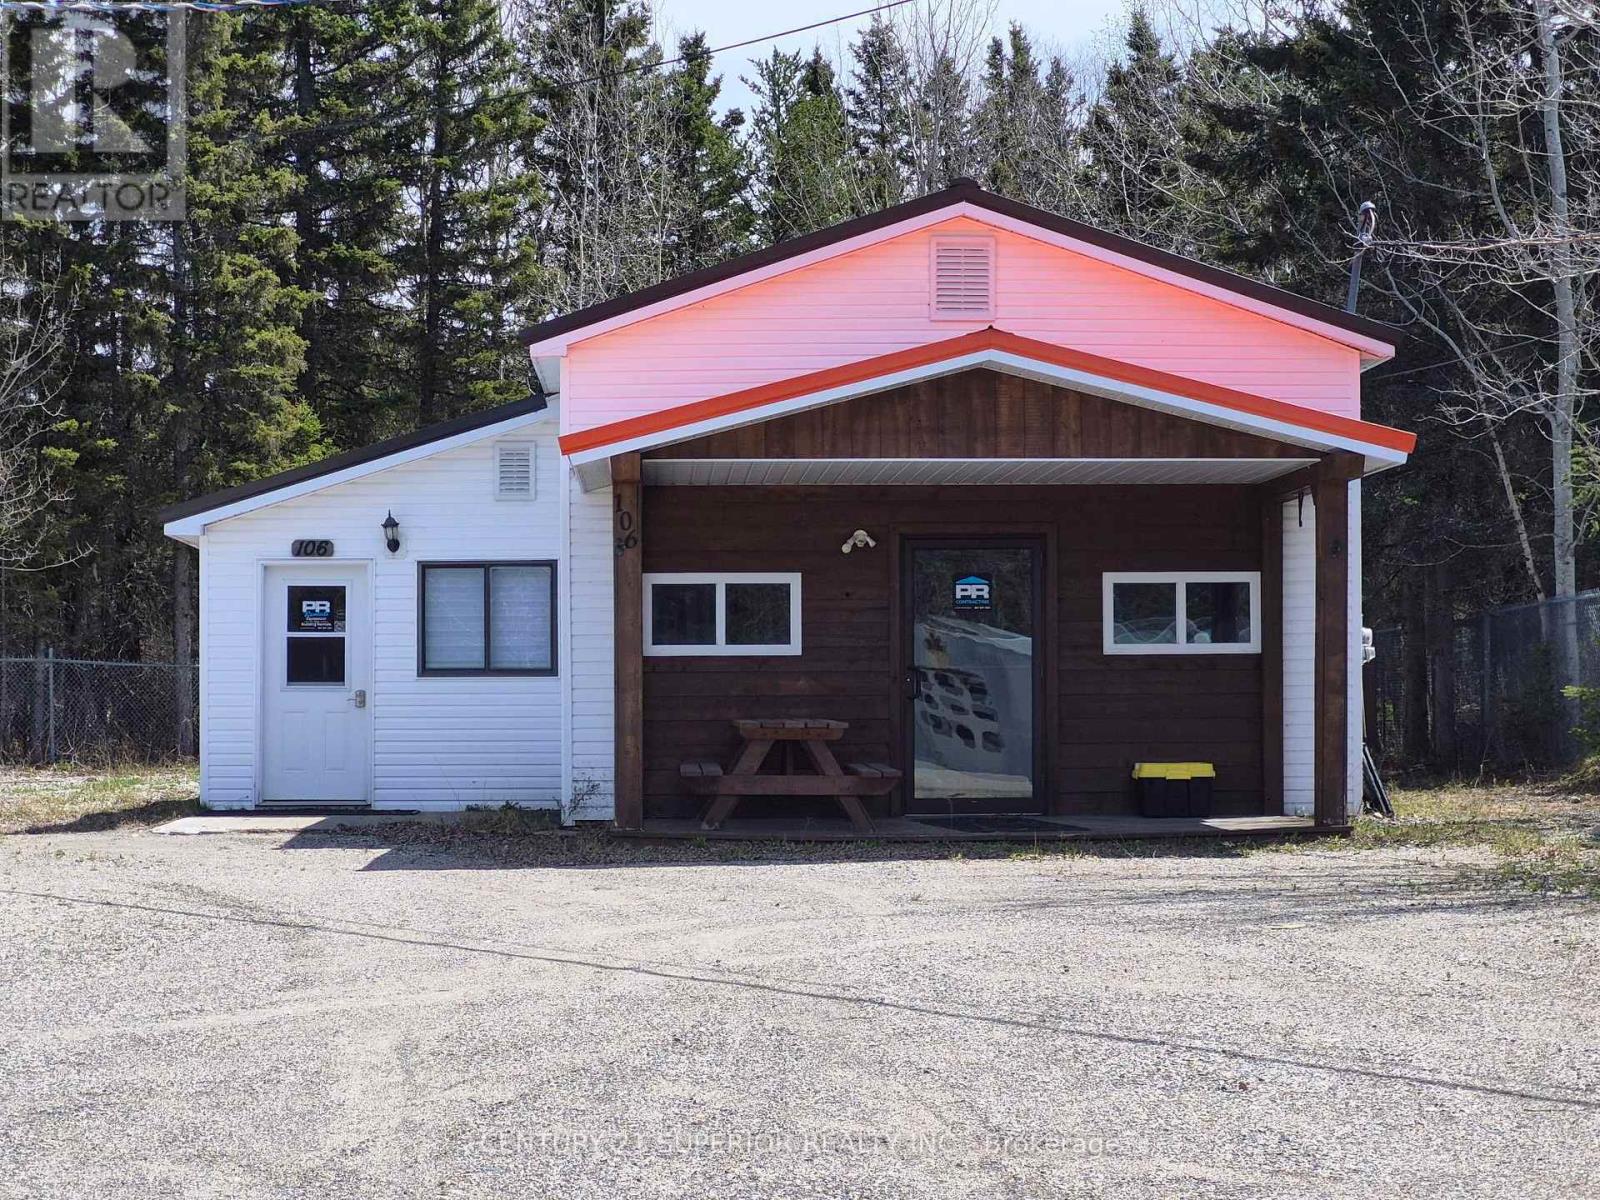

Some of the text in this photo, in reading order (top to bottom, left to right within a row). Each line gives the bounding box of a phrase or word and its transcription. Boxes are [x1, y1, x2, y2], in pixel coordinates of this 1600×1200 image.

[294, 539, 329, 556] 106
[955, 584, 989, 599] PR
[302, 600, 330, 613] PR
